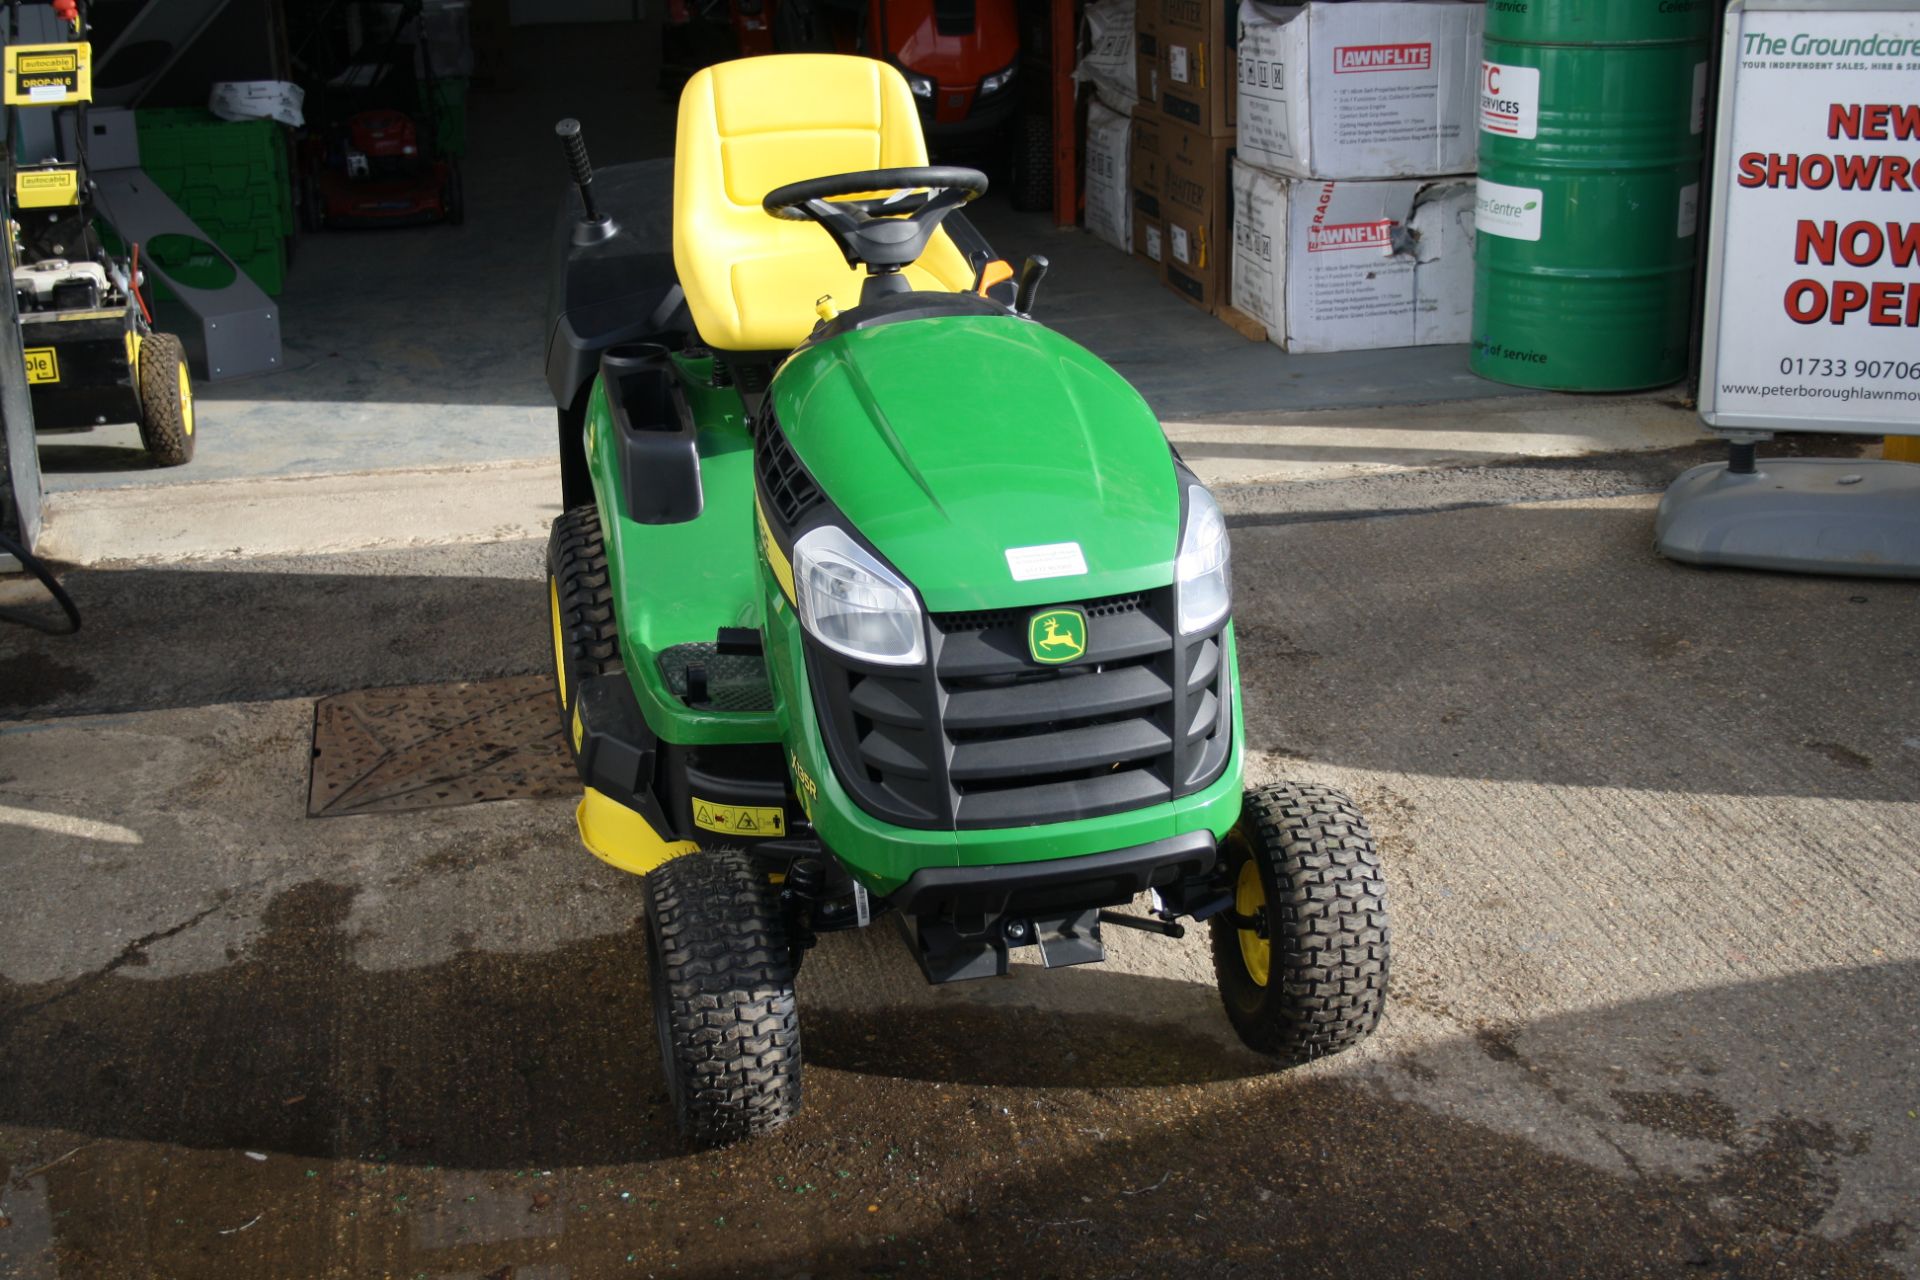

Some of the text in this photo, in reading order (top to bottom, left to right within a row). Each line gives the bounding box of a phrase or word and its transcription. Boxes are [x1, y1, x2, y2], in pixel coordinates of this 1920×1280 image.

[1743, 33, 1787, 56] The
[1334, 47, 1430, 73] LAWNFLITE
[1742, 61, 1766, 69] YOUR
[1769, 61, 1833, 70] INDEPENDENT
[1871, 63, 1893, 71] HIRE
[65, 77, 72, 86] 6
[1827, 103, 1920, 141] NEW
[1737, 152, 1920, 192] SHOWR
[1311, 180, 1336, 234] FRAGIL
[1489, 200, 1522, 218] Centre
[1308, 222, 1393, 251] LAWNFLIT
[1794, 219, 1920, 268] NOW
[1490, 344, 1548, 364] of service
[1780, 357, 1847, 378] 01733
[1722, 384, 1920, 402] www.peterboroughlawnmo
